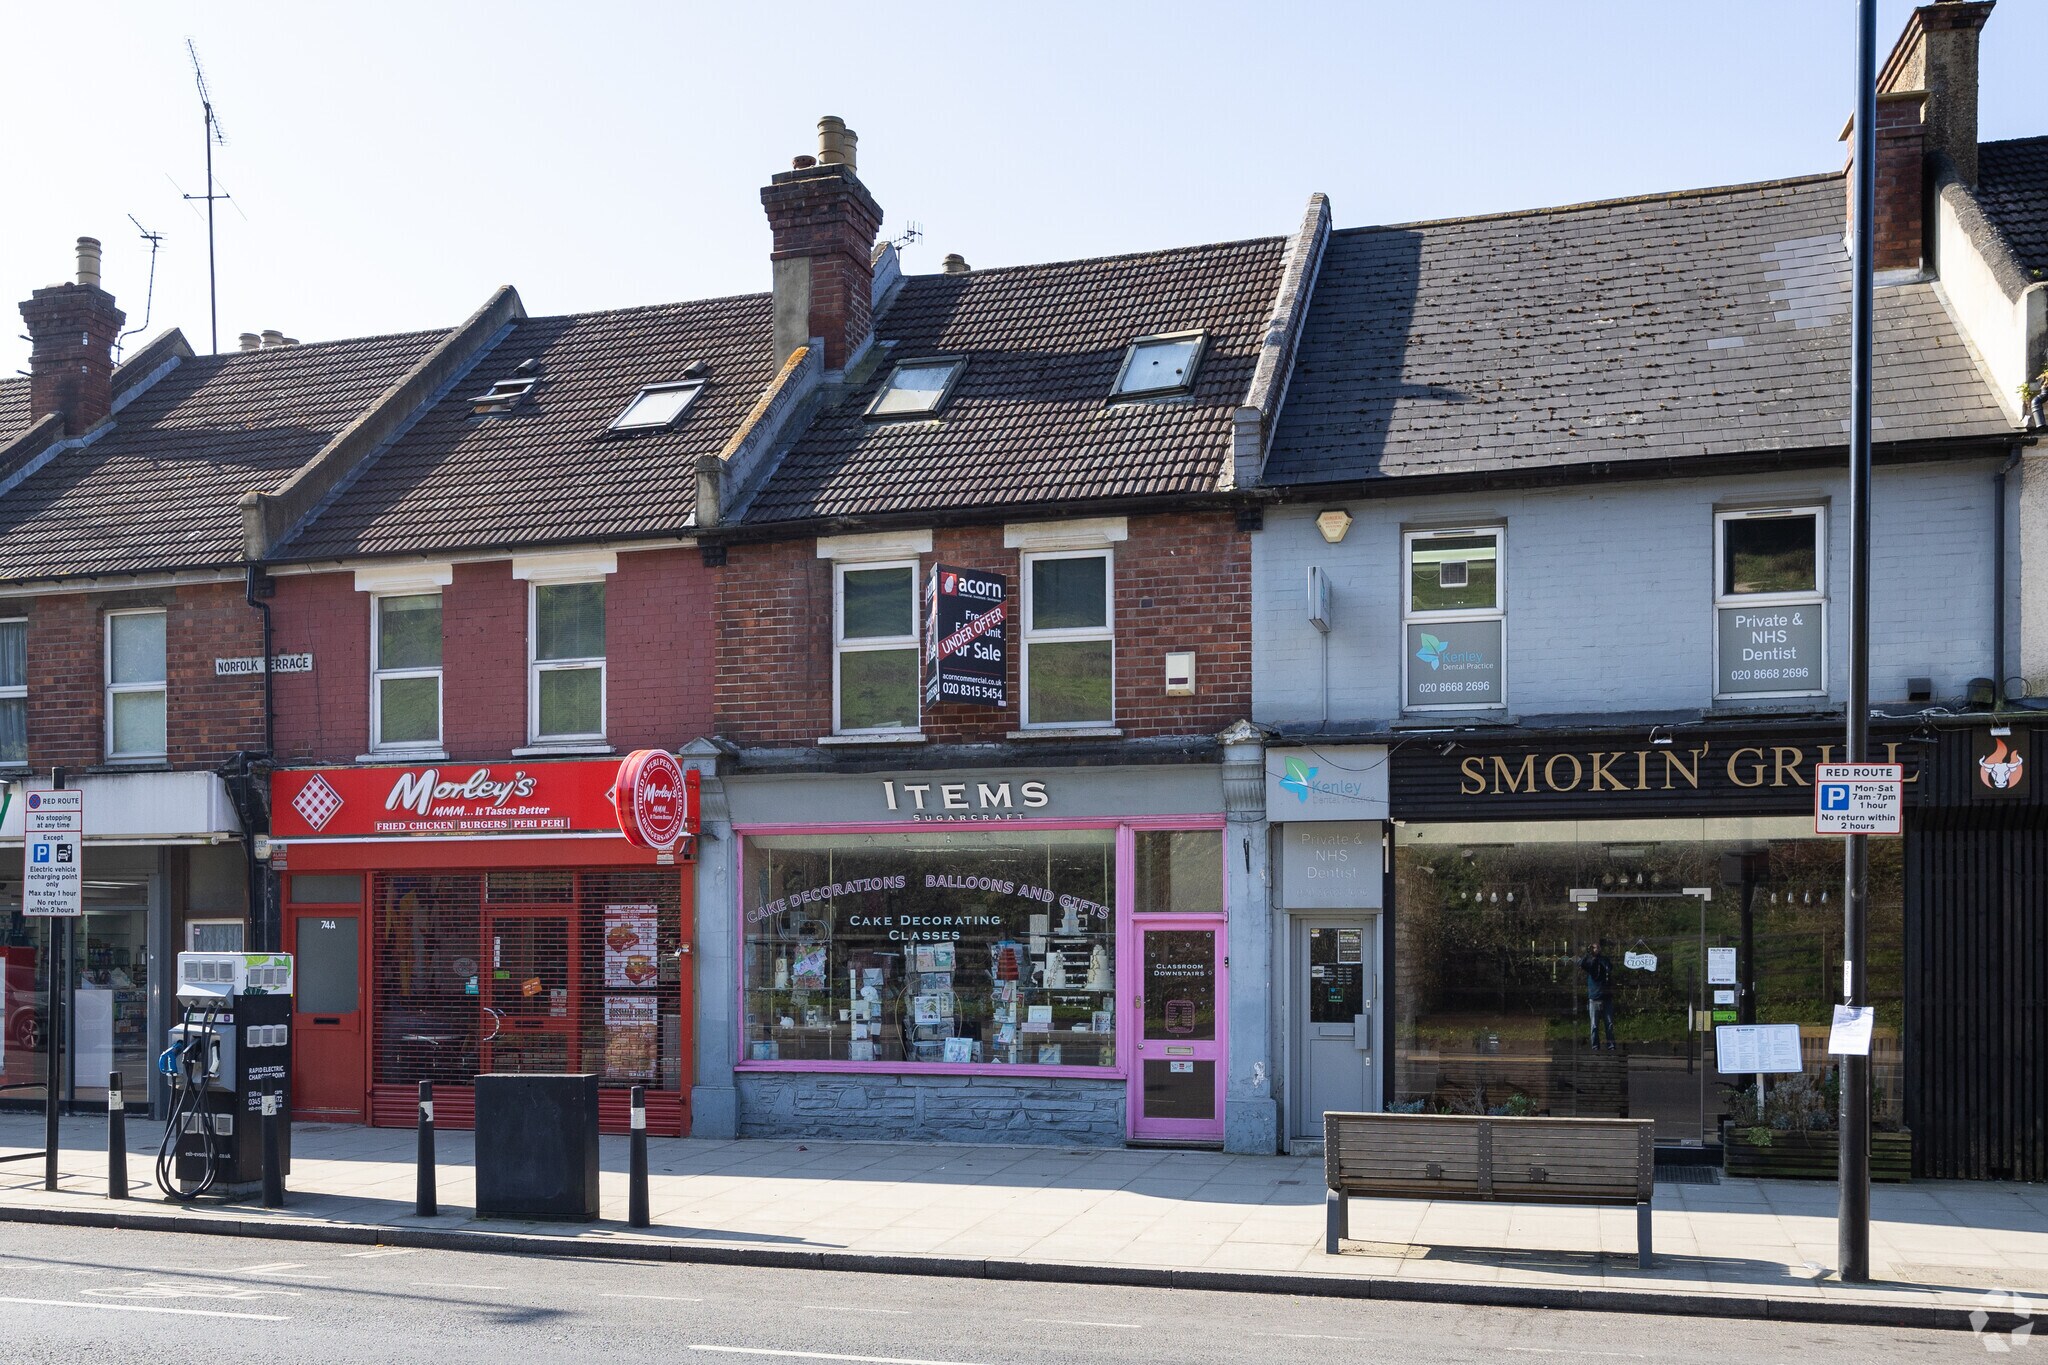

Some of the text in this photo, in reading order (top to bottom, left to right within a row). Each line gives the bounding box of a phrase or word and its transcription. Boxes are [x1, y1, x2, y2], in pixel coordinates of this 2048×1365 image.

[958, 577, 1002, 598] acorn
[1735, 612, 1804, 628] Private &
[942, 628, 974, 654] UNDER
[974, 608, 1004, 633] OFFER
[1752, 630, 1787, 644] NHS
[974, 642, 1001, 661] Sale
[1442, 652, 1483, 664] Kenley
[1742, 646, 1797, 661] Dentist
[218, 657, 309, 672] NORFOLK ERRACE
[1442, 662, 1494, 671] Dental Practice
[942, 674, 1002, 686] acorncommercial.co.uk
[1731, 667, 1809, 680] 020 8668 2696
[943, 682, 959, 694] 020
[960, 684, 980, 697] 8315
[982, 687, 1002, 700] 5454
[1419, 680, 1490, 693] 020 8668 2696
[1461, 740, 1710, 795] SMOKIN'
[1826, 768, 1893, 776] RED ROUTE
[384, 768, 537, 816] Morley's
[646, 758, 660, 772] PERI
[660, 758, 672, 772] PERI
[672, 769, 682, 813] CHICKEN
[1312, 780, 1362, 796] Kenley
[644, 783, 677, 804] Morley's
[882, 780, 1049, 810] ITEMS
[475, 806, 485, 816] It
[485, 806, 516, 816] Tastes
[518, 805, 550, 815] Better
[513, 819, 565, 829] PERI PERI
[913, 813, 1024, 822] SUGARCRAFT
[376, 821, 454, 831] FRIED CHICKEN
[459, 820, 508, 829] BURGERS
[642, 817, 664, 841] BURGERS
[1301, 832, 1363, 845] Private &
[1316, 850, 1348, 861] NHS
[1307, 866, 1357, 879] Dentist
[746, 875, 906, 924] CAKE DECORATIONS
[925, 874, 1110, 920] BALLOONS AND GIFTS
[321, 921, 336, 929] 74A
[850, 915, 1000, 926] CAKE DECORATING
[889, 931, 960, 941] CLASSES
